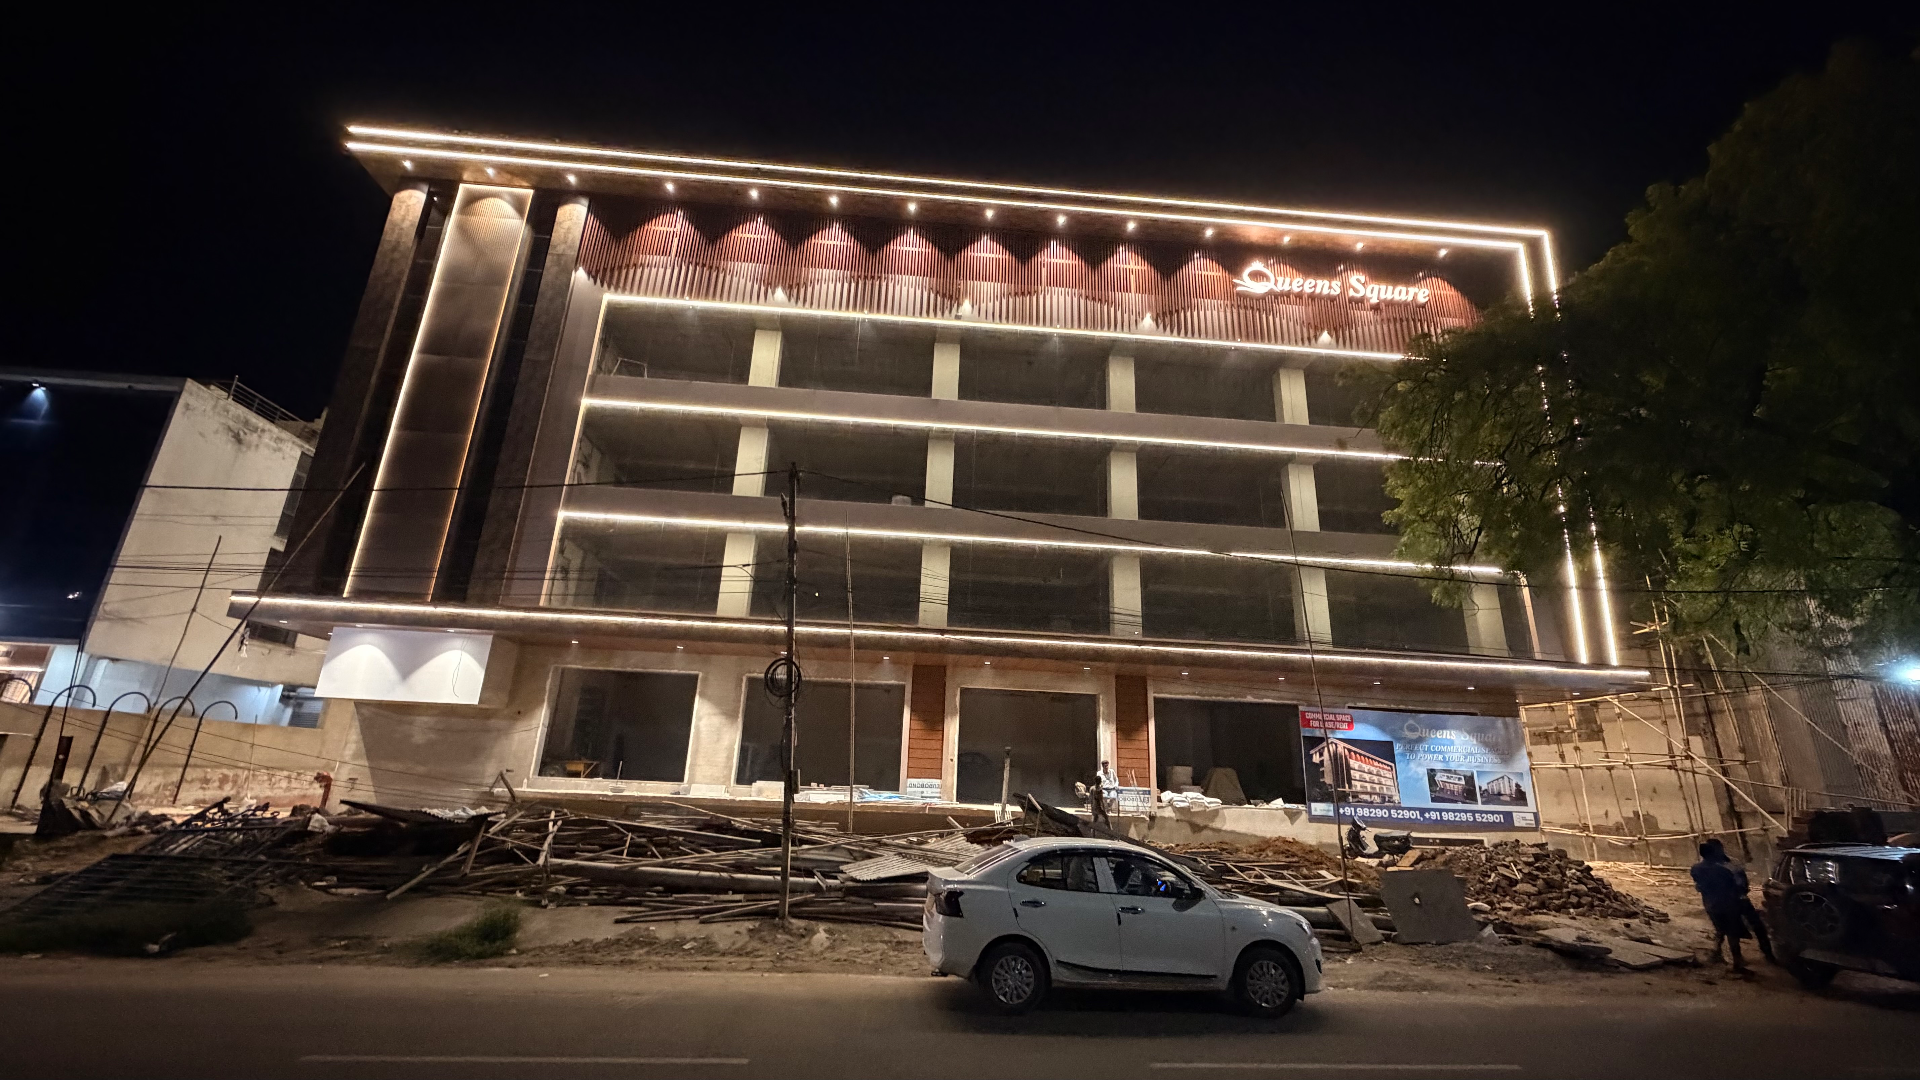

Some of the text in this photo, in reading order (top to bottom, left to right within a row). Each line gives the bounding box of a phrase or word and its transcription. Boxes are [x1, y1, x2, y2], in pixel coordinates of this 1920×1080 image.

[1234, 260, 1430, 303] Queens Square
[1336, 714, 1351, 722] SPACE
[1320, 721, 1348, 729] LASE/RENT
[1402, 720, 1456, 740] Queens
[1396, 743, 1429, 752] PERFECT
[1430, 745, 1480, 754] COMMERCIAL
[1406, 752, 1416, 760] TO
[1467, 756, 1502, 764] BUSINESS
[1339, 807, 1355, 816] +91
[1356, 808, 1389, 817] 98290
[1391, 809, 1423, 821] 52901,
[1424, 811, 1440, 820] +91
[1442, 812, 1473, 822] 98295
[1475, 813, 1505, 823] 52901
